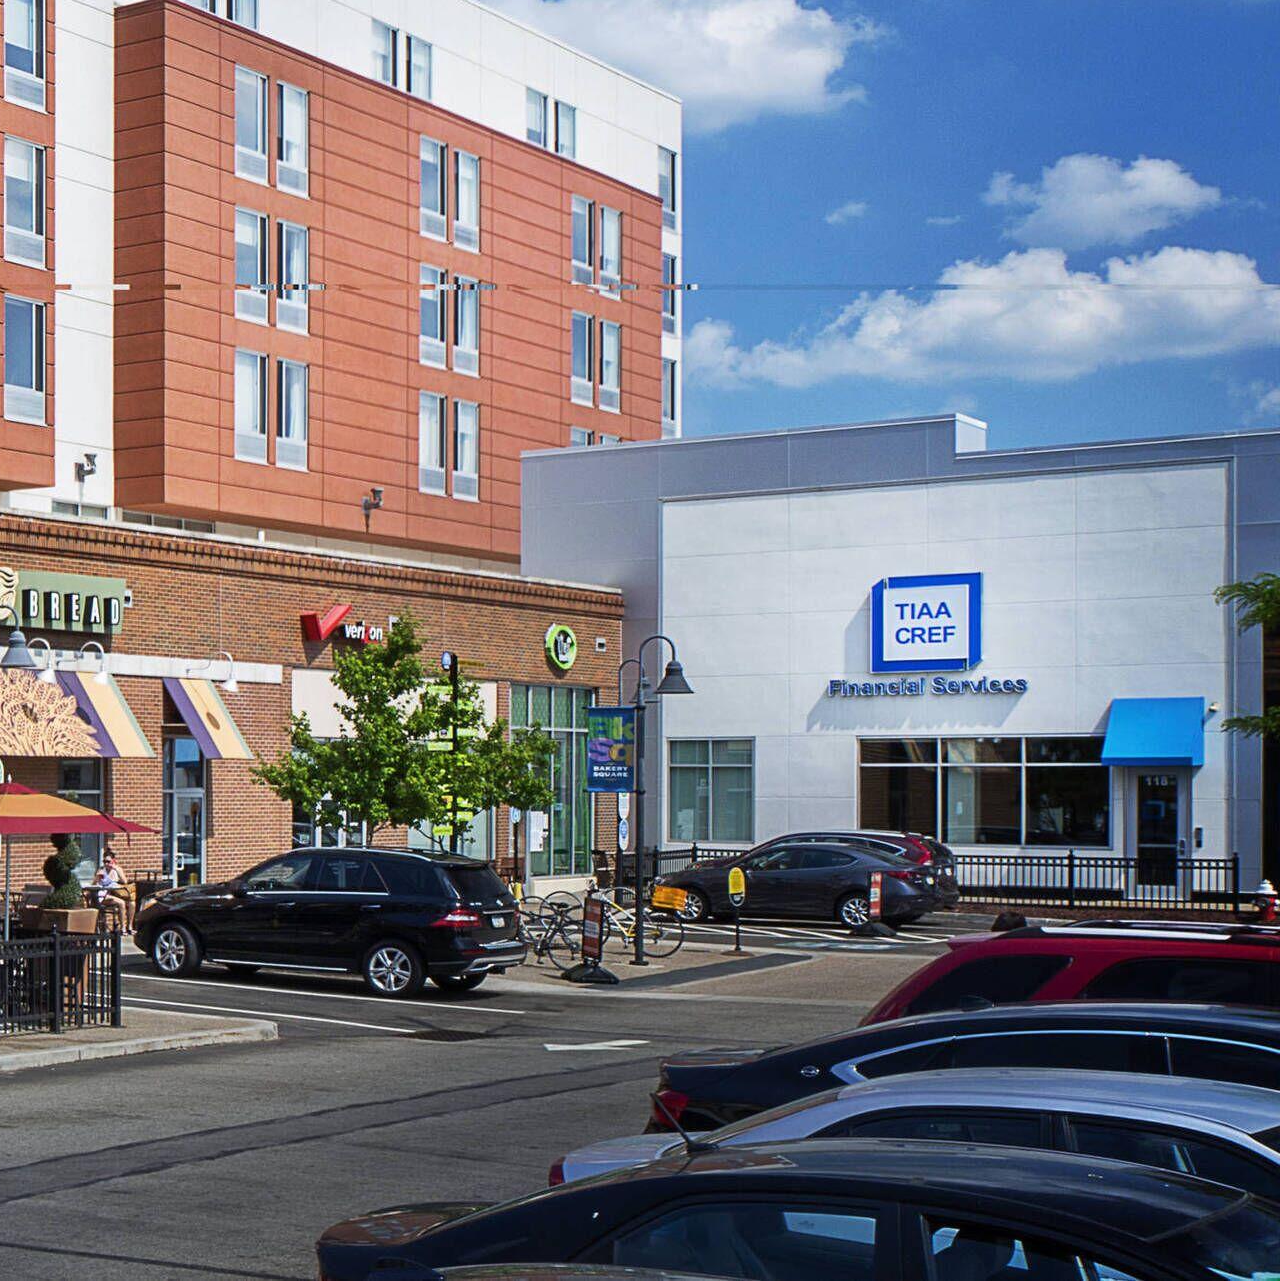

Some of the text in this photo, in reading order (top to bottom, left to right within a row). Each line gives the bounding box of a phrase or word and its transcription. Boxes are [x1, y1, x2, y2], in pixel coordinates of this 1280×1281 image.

[29, 589, 120, 625] BREAD
[895, 602, 952, 620] TIAA
[895, 625, 956, 645] CREF
[827, 675, 1028, 698] Financial Services
